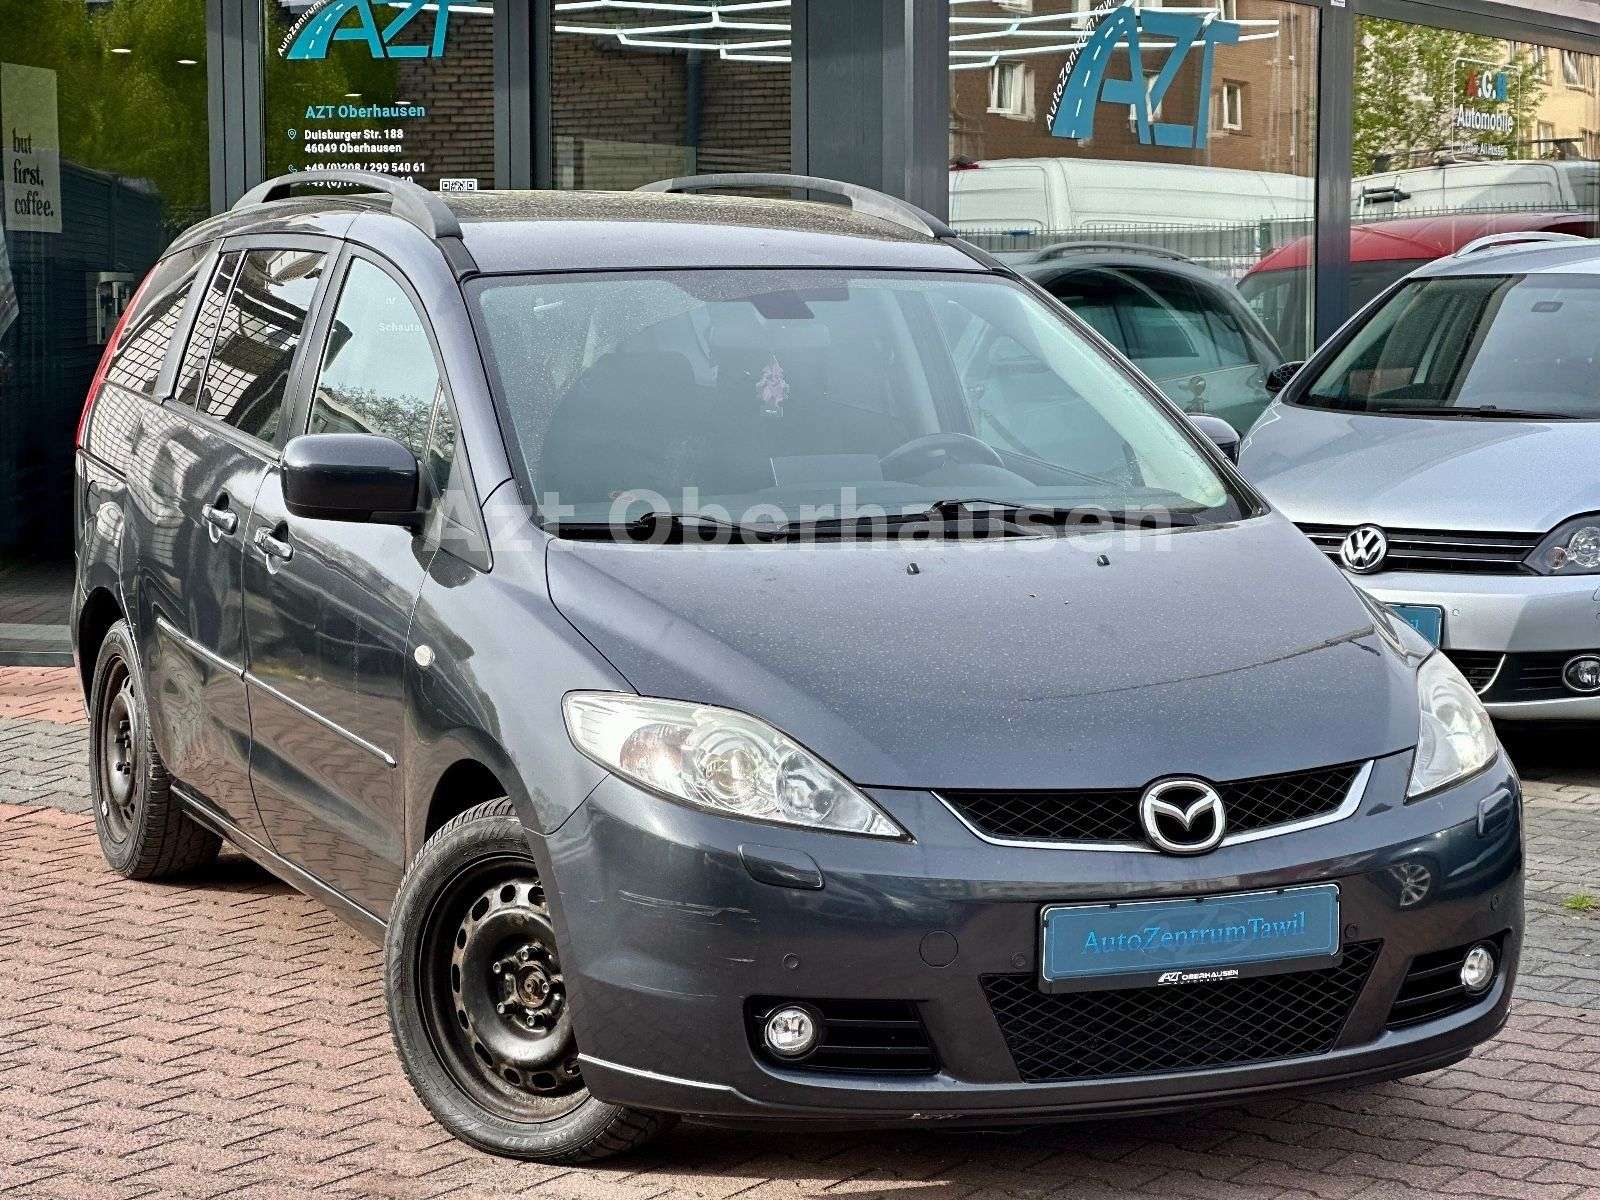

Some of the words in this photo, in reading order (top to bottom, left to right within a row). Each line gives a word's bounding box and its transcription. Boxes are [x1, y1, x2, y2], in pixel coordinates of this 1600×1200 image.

[1051, 4, 1241, 150] AZT
[305, 105, 335, 119] AZT
[338, 103, 426, 118] Oberhausen
[12, 127, 32, 155] but
[304, 129, 362, 141] Duisburger
[364, 128, 382, 139] Str.
[384, 128, 404, 139] 188
[304, 143, 338, 154] 46049
[340, 142, 402, 153] Oberhausen
[370, 162, 389, 172] 299
[391, 162, 411, 172] 540
[413, 162, 425, 172] 61
[1081, 911, 1305, 954] AutoZentrumTawil
